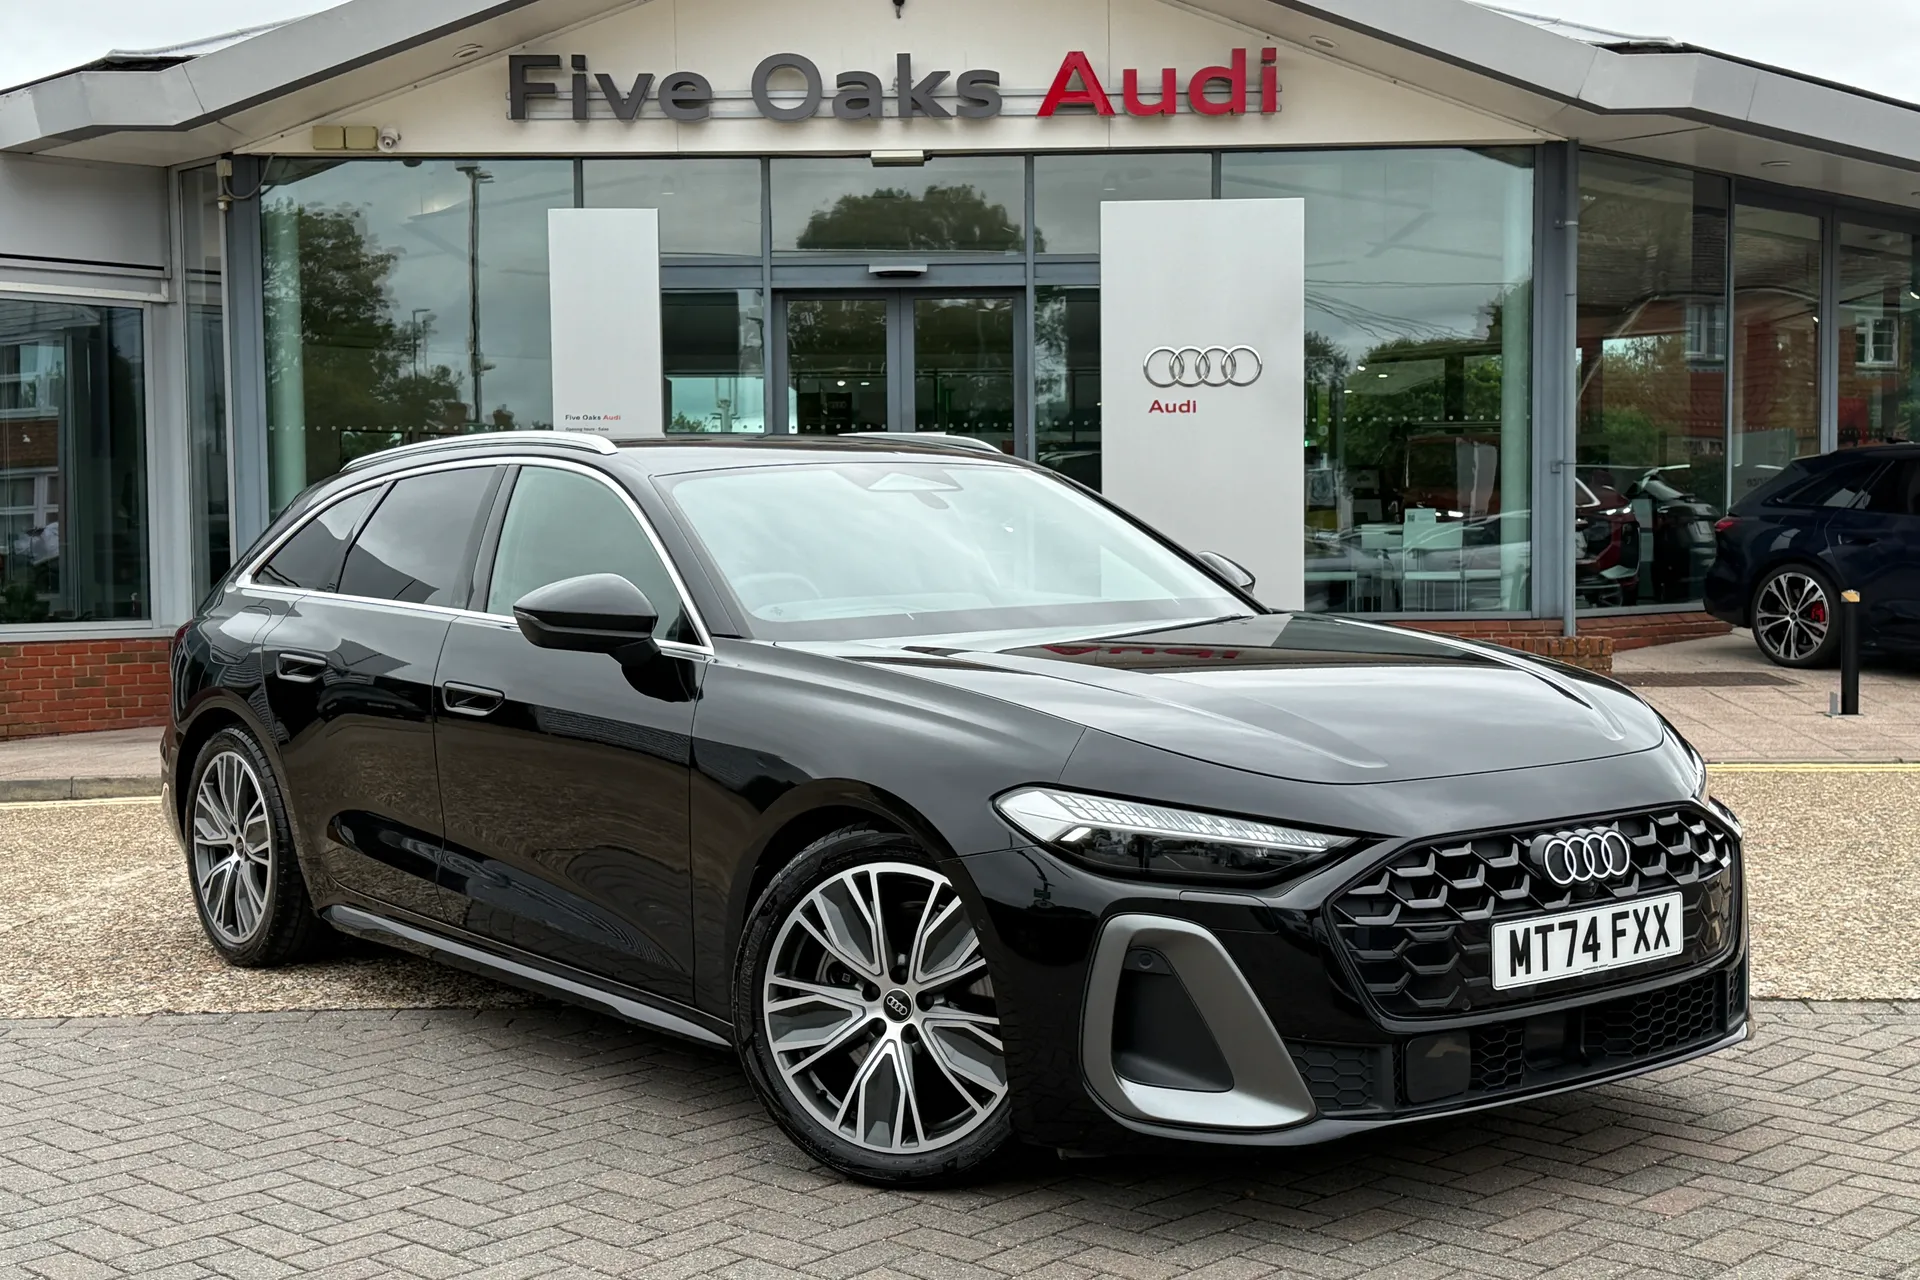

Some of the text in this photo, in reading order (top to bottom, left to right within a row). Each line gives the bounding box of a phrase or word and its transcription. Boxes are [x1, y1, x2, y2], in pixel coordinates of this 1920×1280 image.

[508, 47, 1277, 122] Five Oaks Audi
[1148, 399, 1197, 414] Audi
[1509, 902, 1671, 978] MT74 FXX
